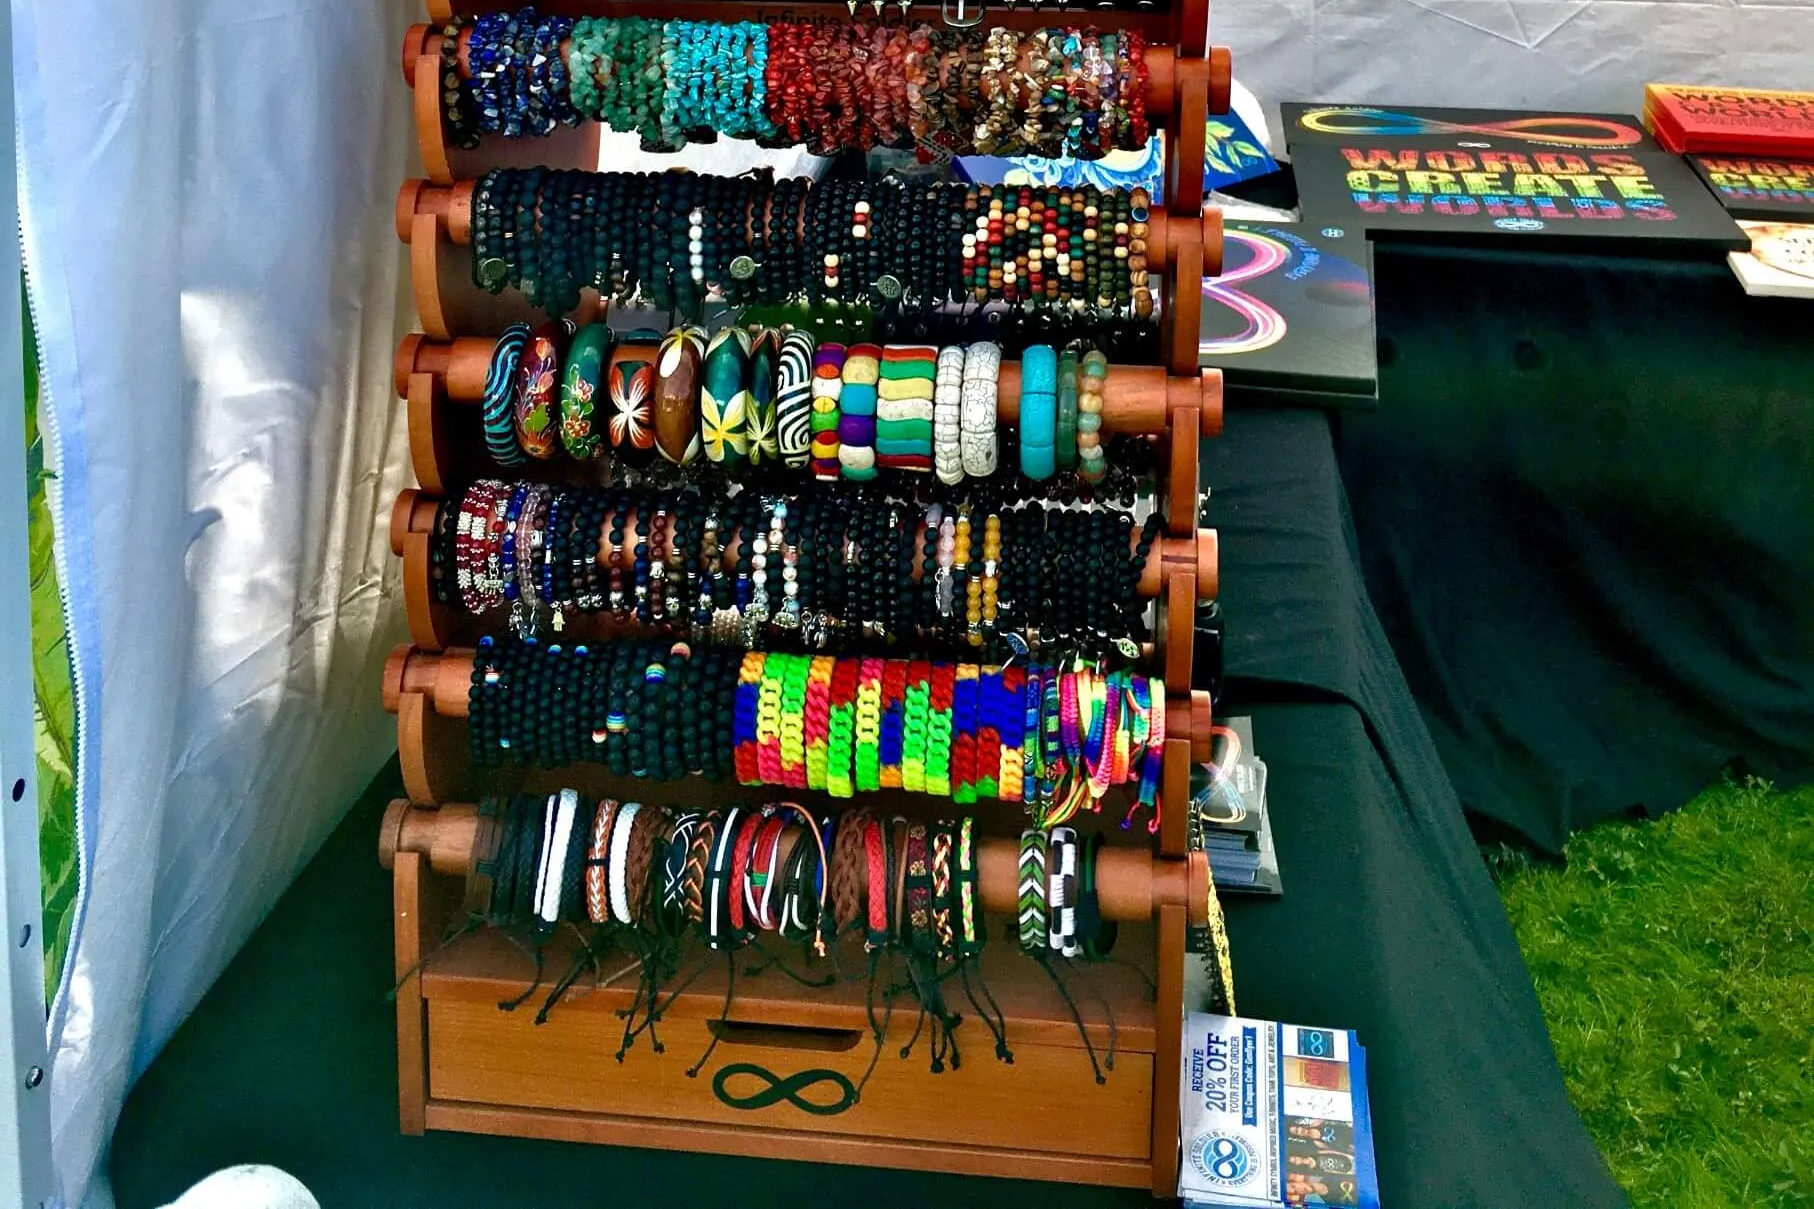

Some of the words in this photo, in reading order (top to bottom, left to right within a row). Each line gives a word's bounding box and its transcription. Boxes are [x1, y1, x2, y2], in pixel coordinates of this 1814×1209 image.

[1340, 148, 1646, 175] WORDS
[1347, 170, 1664, 200] CREATE
[1351, 192, 1678, 221] WORLDS
[1206, 1032, 1228, 1072] OFF
[1230, 1036, 1240, 1065] ORDER
[1192, 1048, 1204, 1092] RECEIVE
[1230, 1066, 1240, 1090] FIRST
[1205, 1077, 1227, 1113] 20%
[1230, 1091, 1240, 1113] YOUR
